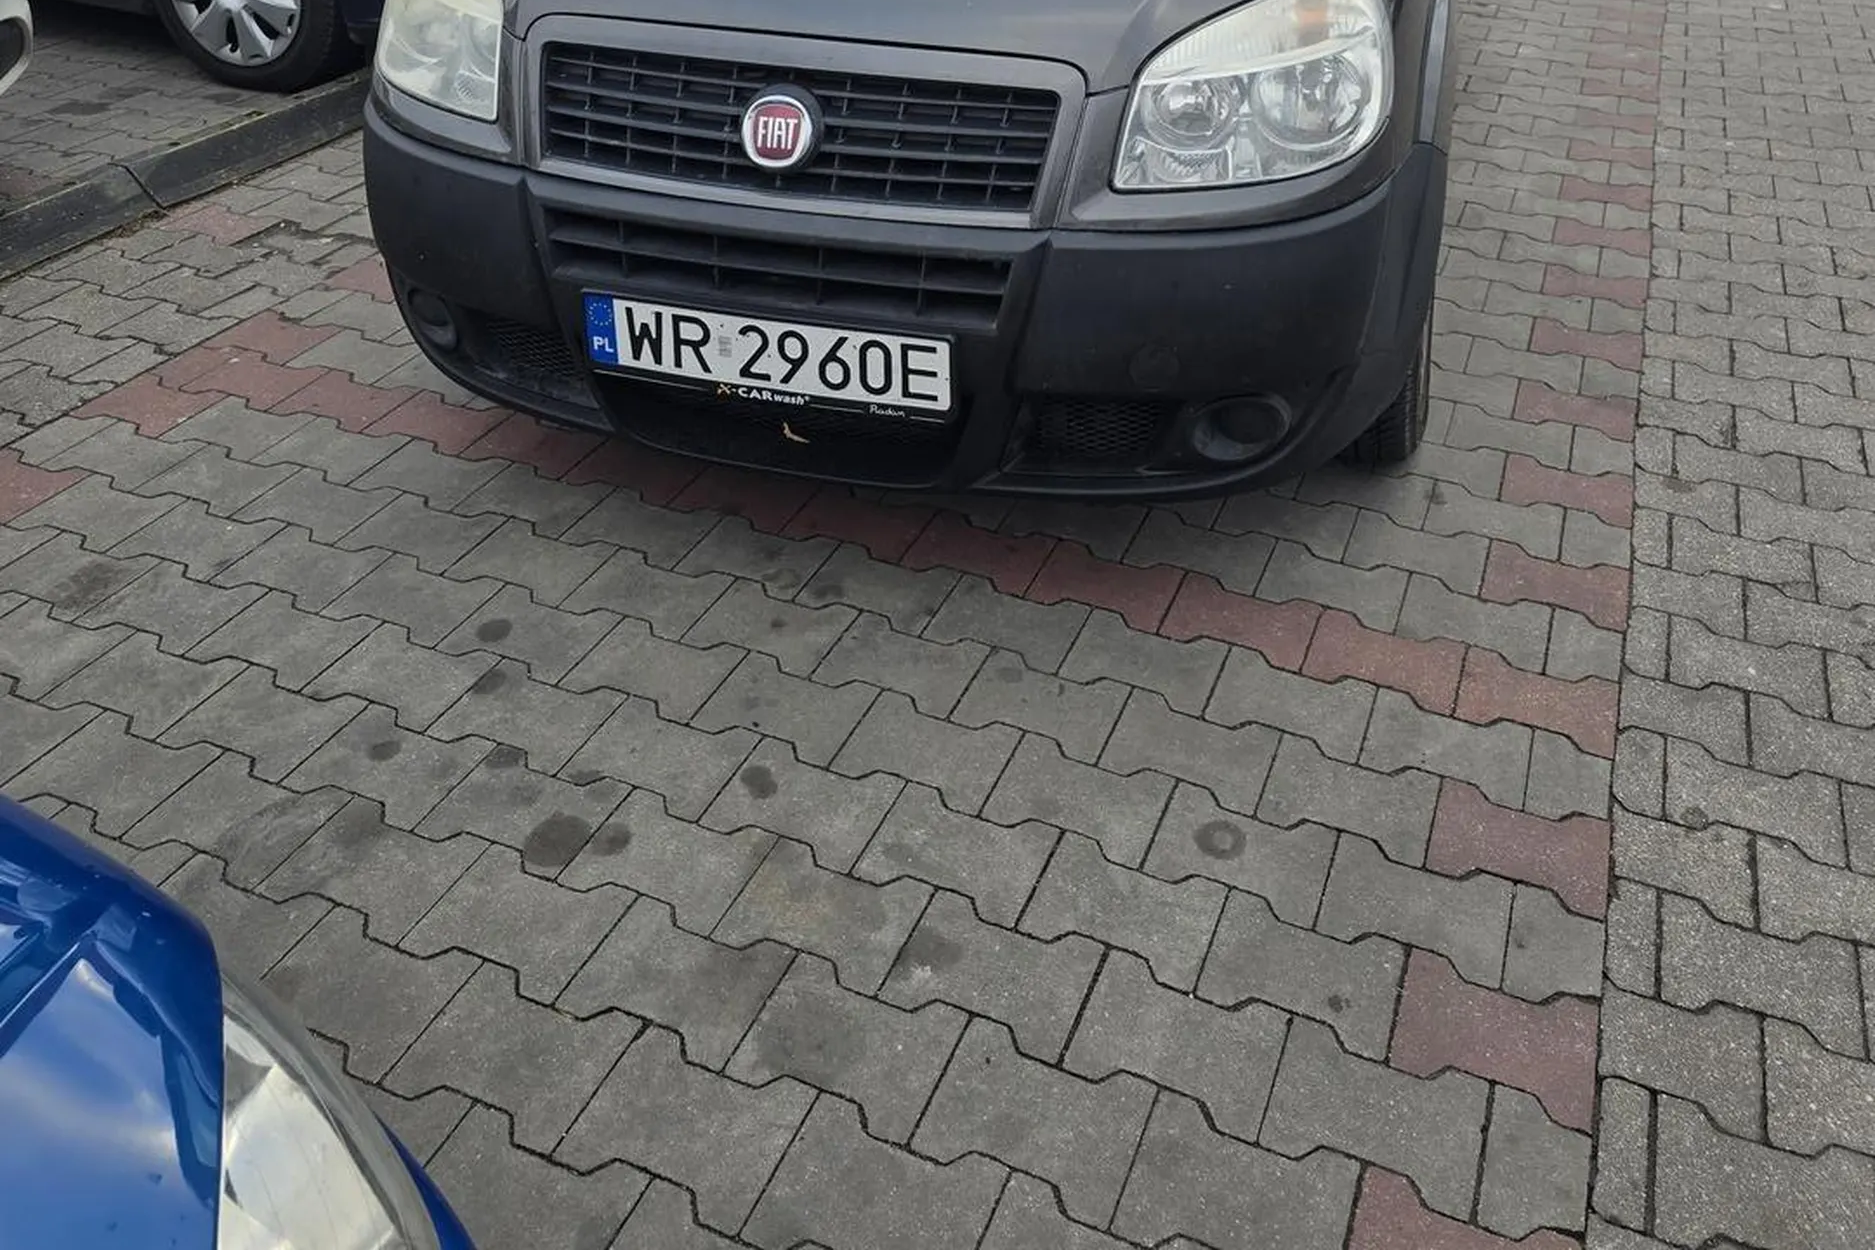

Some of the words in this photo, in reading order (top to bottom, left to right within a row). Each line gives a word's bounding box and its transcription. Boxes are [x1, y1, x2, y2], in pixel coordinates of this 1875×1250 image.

[757, 116, 799, 150] FIAT
[593, 336, 614, 353] PL
[625, 306, 713, 374] WR
[738, 324, 940, 402] 2960E
